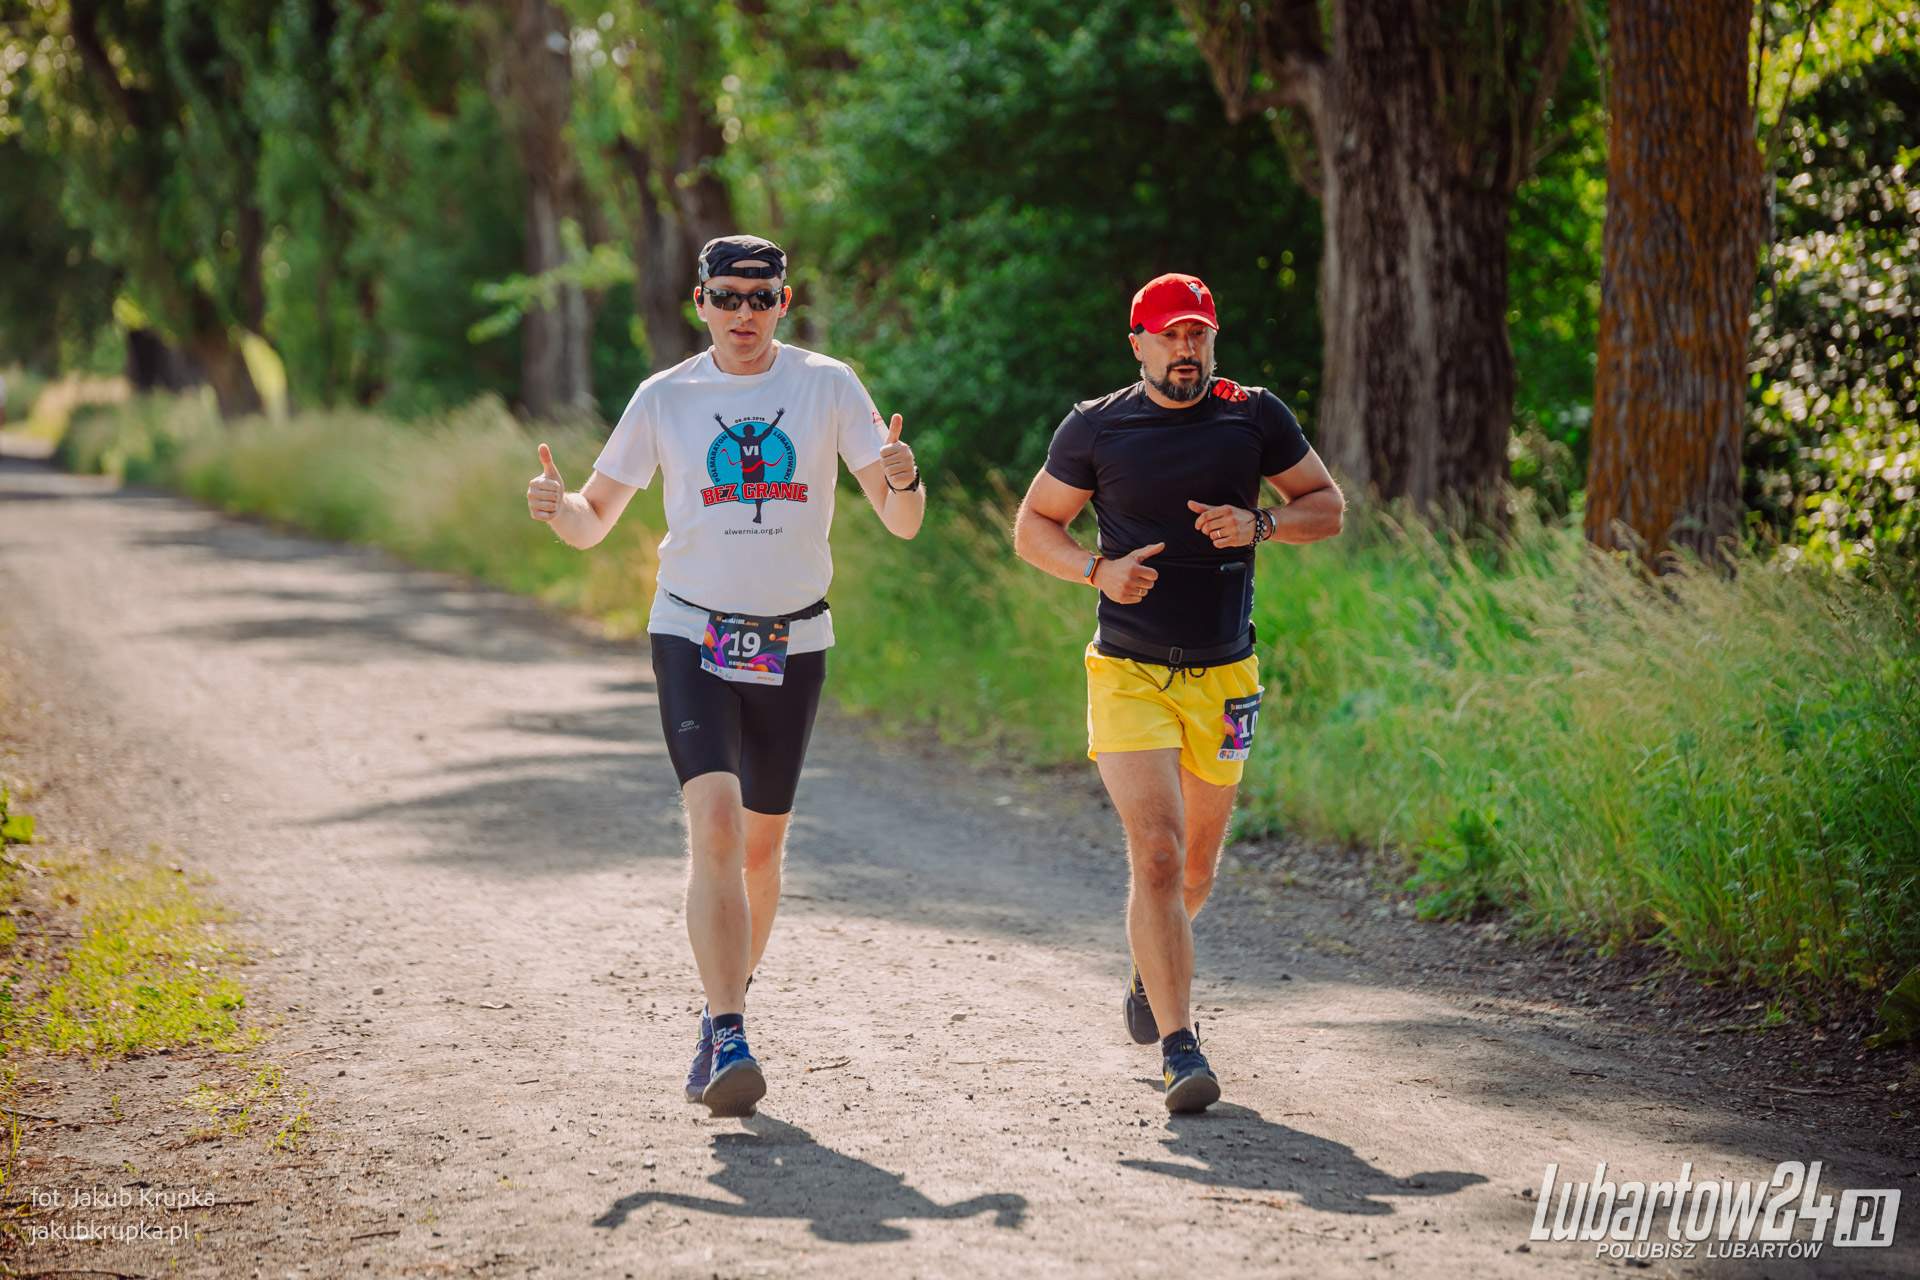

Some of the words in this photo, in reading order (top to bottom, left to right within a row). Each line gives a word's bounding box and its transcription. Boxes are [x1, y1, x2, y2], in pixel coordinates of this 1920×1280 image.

[742, 445, 759, 457] VI
[701, 484, 739, 507] BEZ
[742, 481, 808, 503] GRANIC
[727, 630, 761, 658] 19
